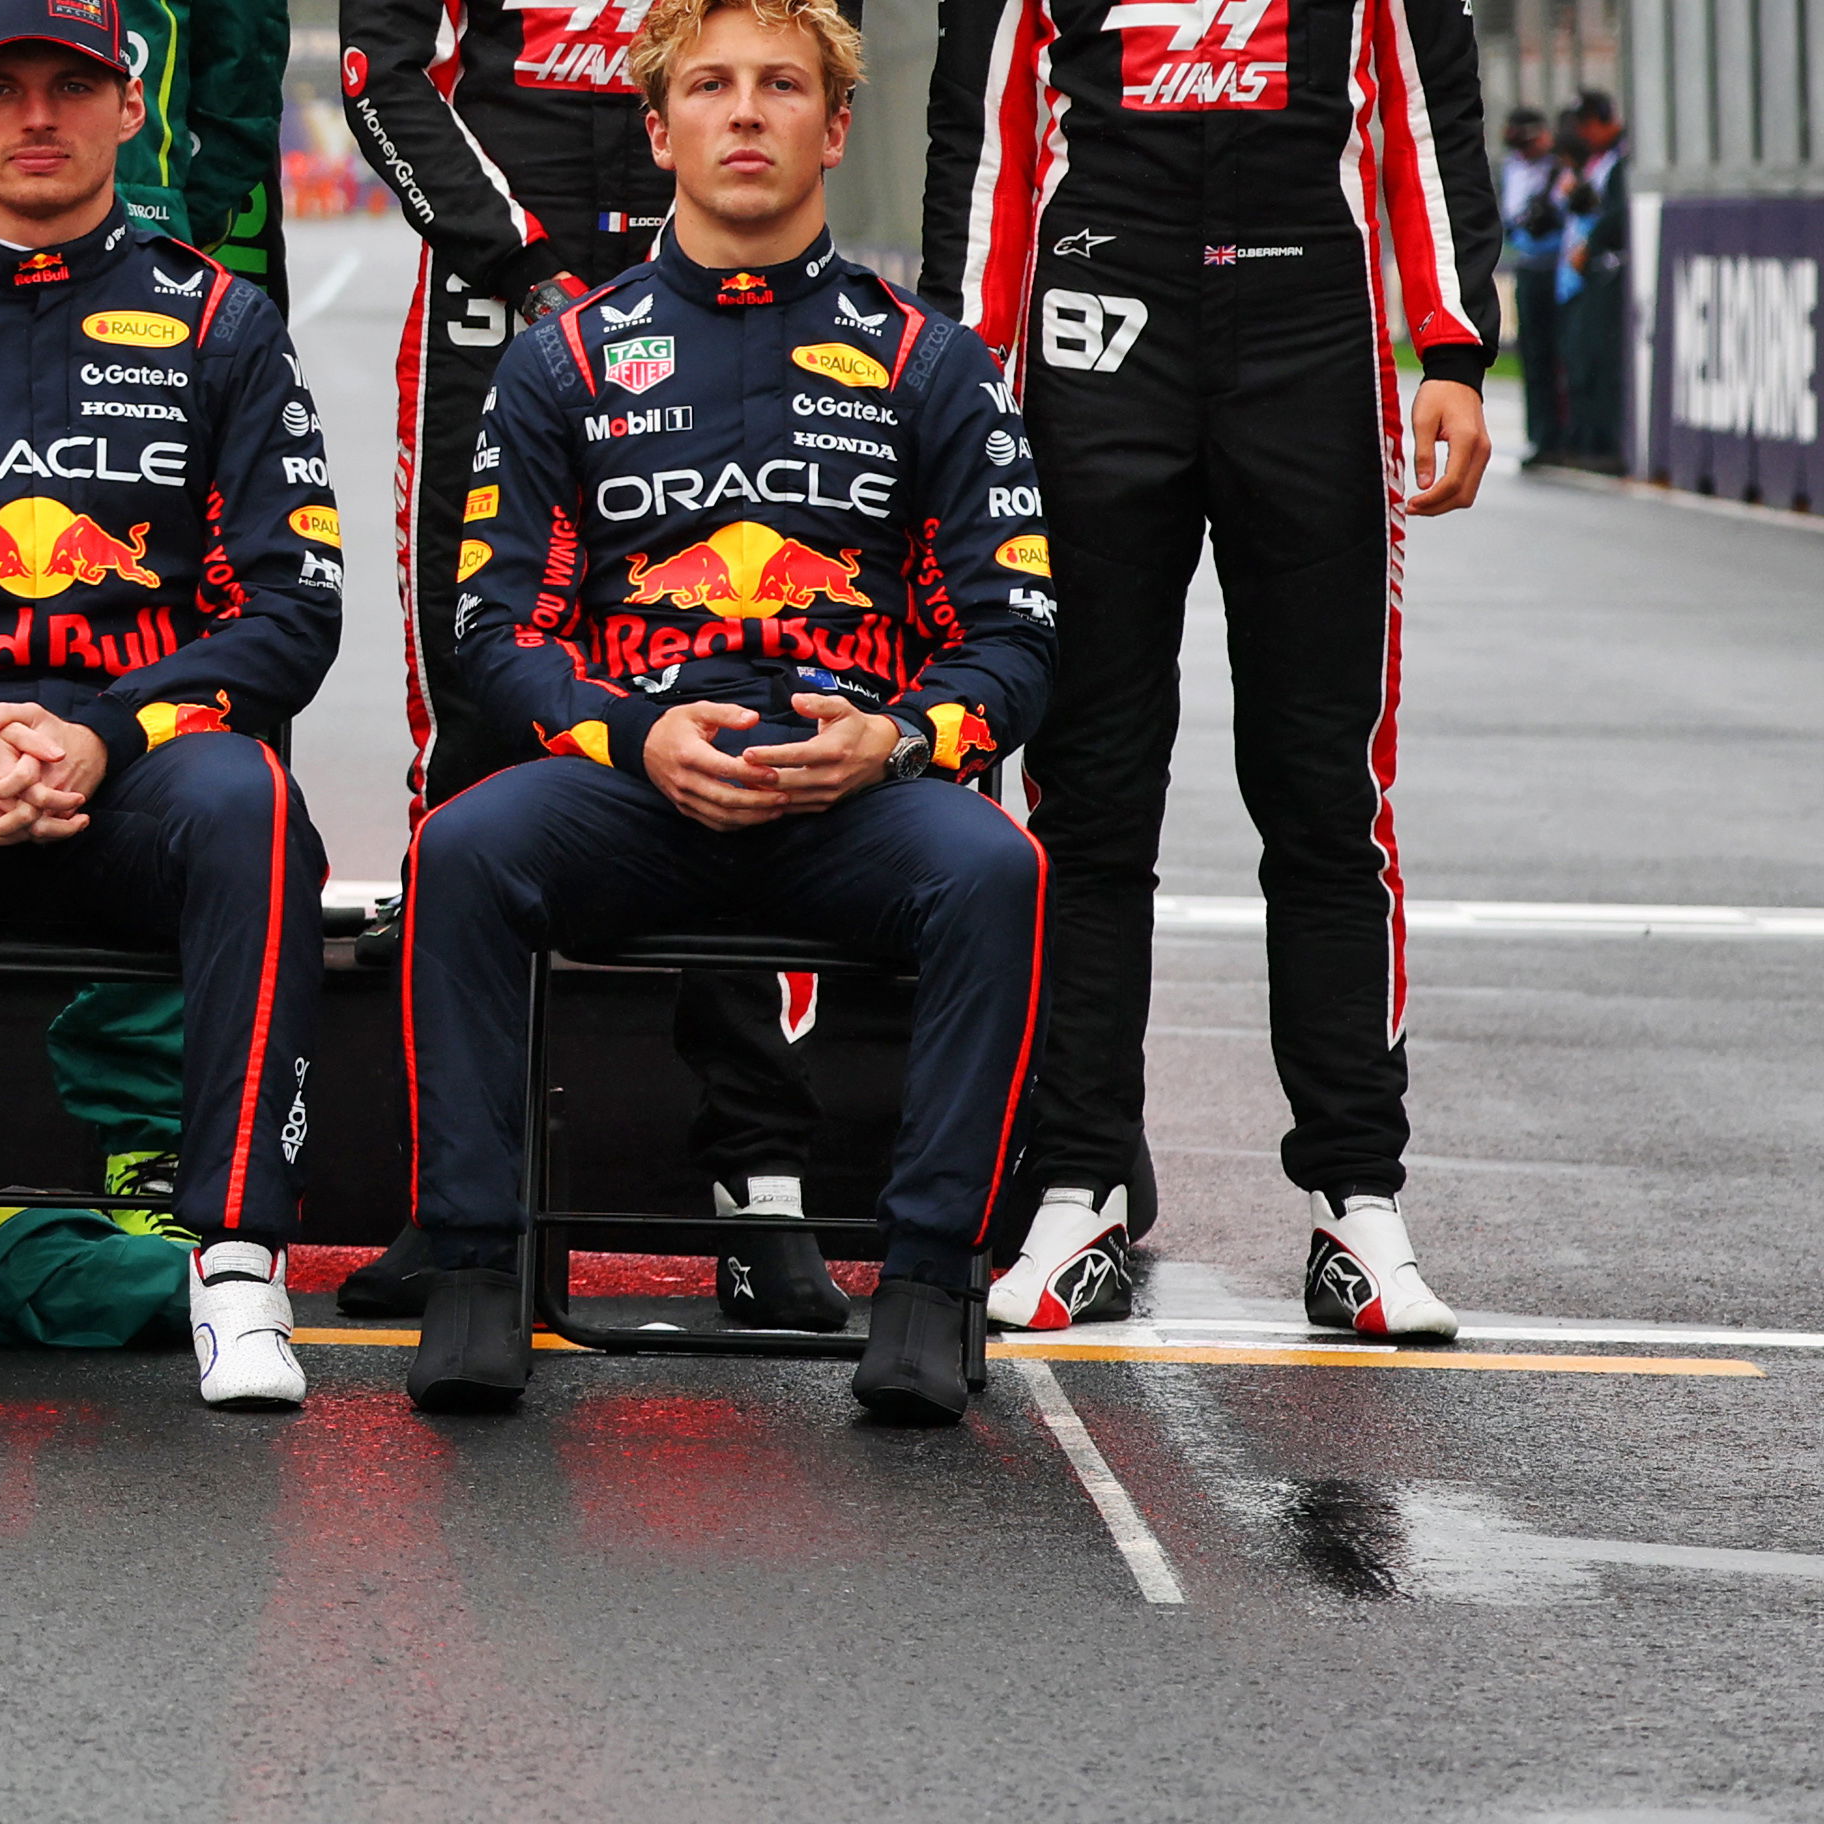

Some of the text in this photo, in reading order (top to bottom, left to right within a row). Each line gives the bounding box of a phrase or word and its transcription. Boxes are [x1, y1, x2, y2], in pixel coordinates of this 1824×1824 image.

[1123, 61, 1287, 104] HAAS
[356, 97, 435, 226] MoneyGram
[128, 203, 170, 221] STROLL
[1237, 246, 1303, 259] O.BEARMAN
[42, 265, 69, 284] Bull
[111, 320, 175, 341] RAUCH
[603, 320, 652, 334] CASTORE
[834, 316, 882, 337] CASTORE
[1042, 288, 1148, 373] 87
[609, 341, 669, 361] TAG
[104, 363, 188, 388] Gate.io
[608, 360, 672, 387] HEUER
[818, 355, 878, 379] RAUCH
[81, 401, 188, 423] HONDA
[585, 407, 661, 442] Mobil
[793, 430, 898, 462] HONDA
[596, 459, 898, 521] ORACLE
[48, 607, 178, 678] Bull
[602, 614, 892, 680] Red Bull
[836, 675, 880, 703] LIAM
